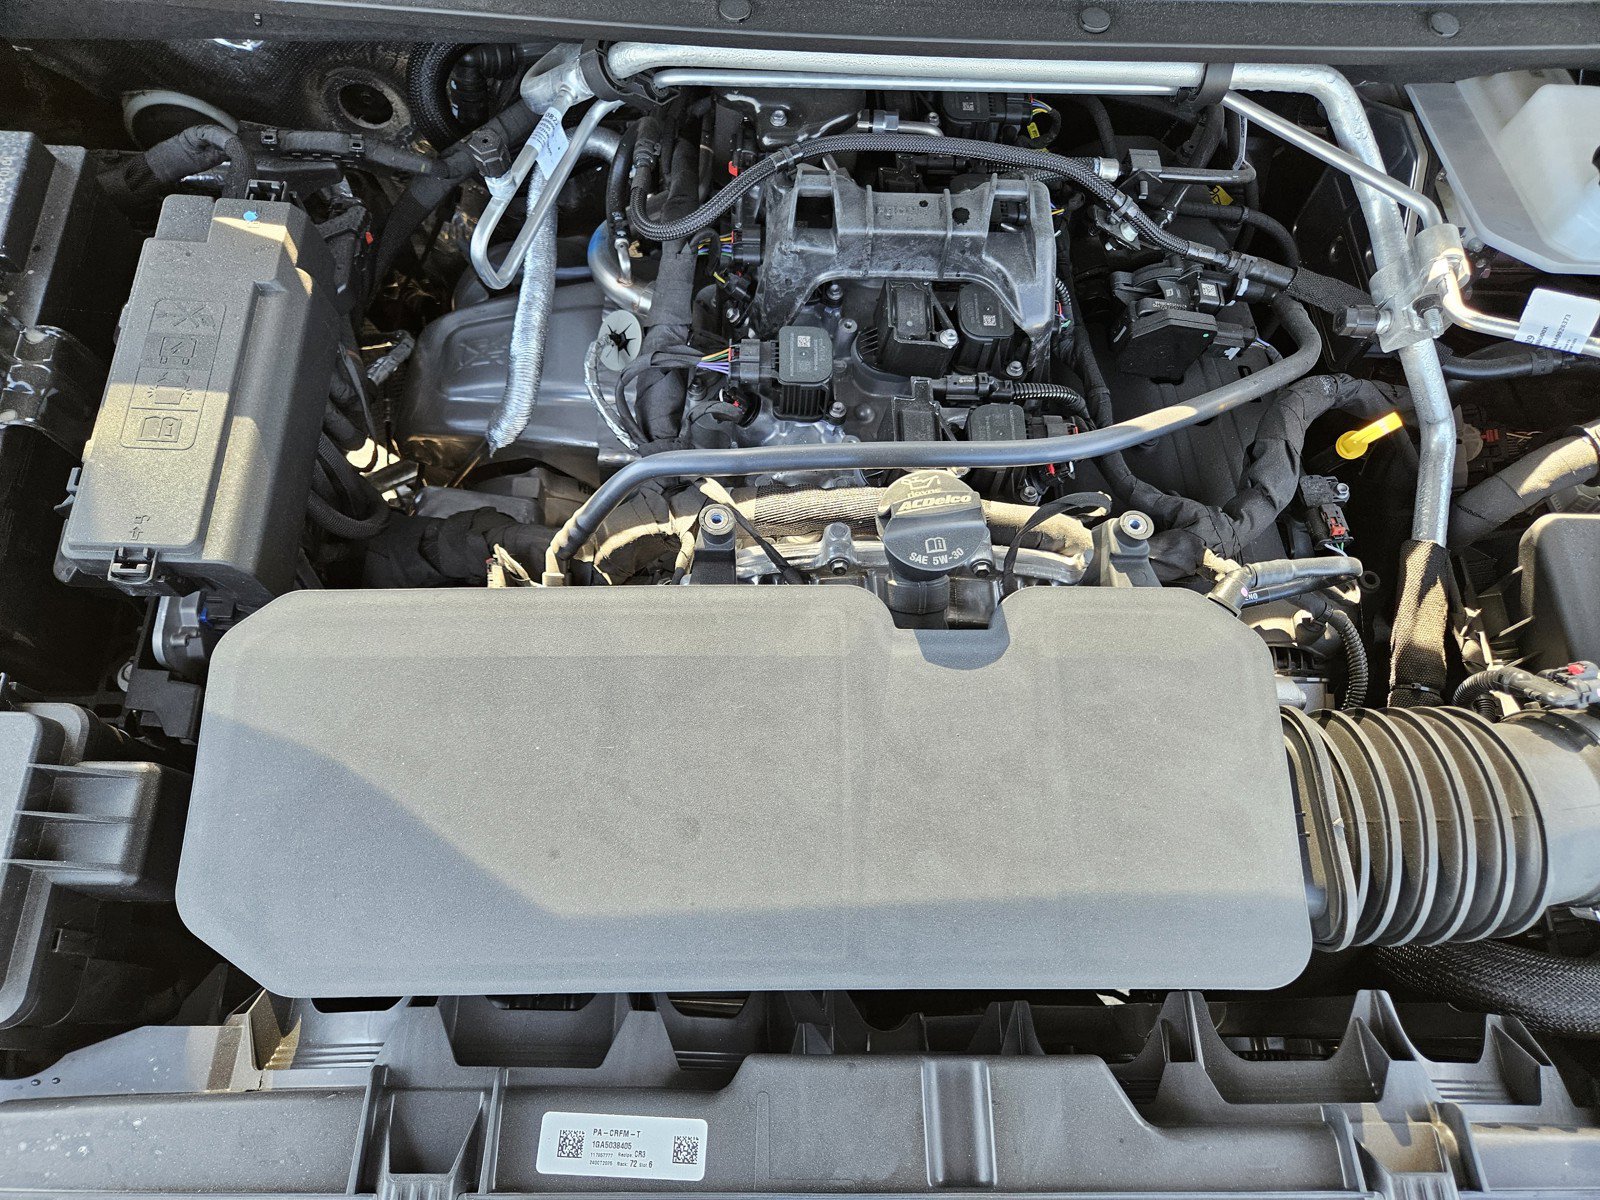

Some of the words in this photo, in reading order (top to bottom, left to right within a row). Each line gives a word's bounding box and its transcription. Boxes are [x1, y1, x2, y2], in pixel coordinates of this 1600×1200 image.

[897, 495, 972, 511] ACDelco
[909, 552, 928, 565] SAE
[932, 548, 964, 565] 5W-30
[592, 1140, 632, 1150] 1GA5038405
[634, 1150, 646, 1158] CR3
[629, 1159, 638, 1168] 72
[648, 1160, 653, 1168] 6
